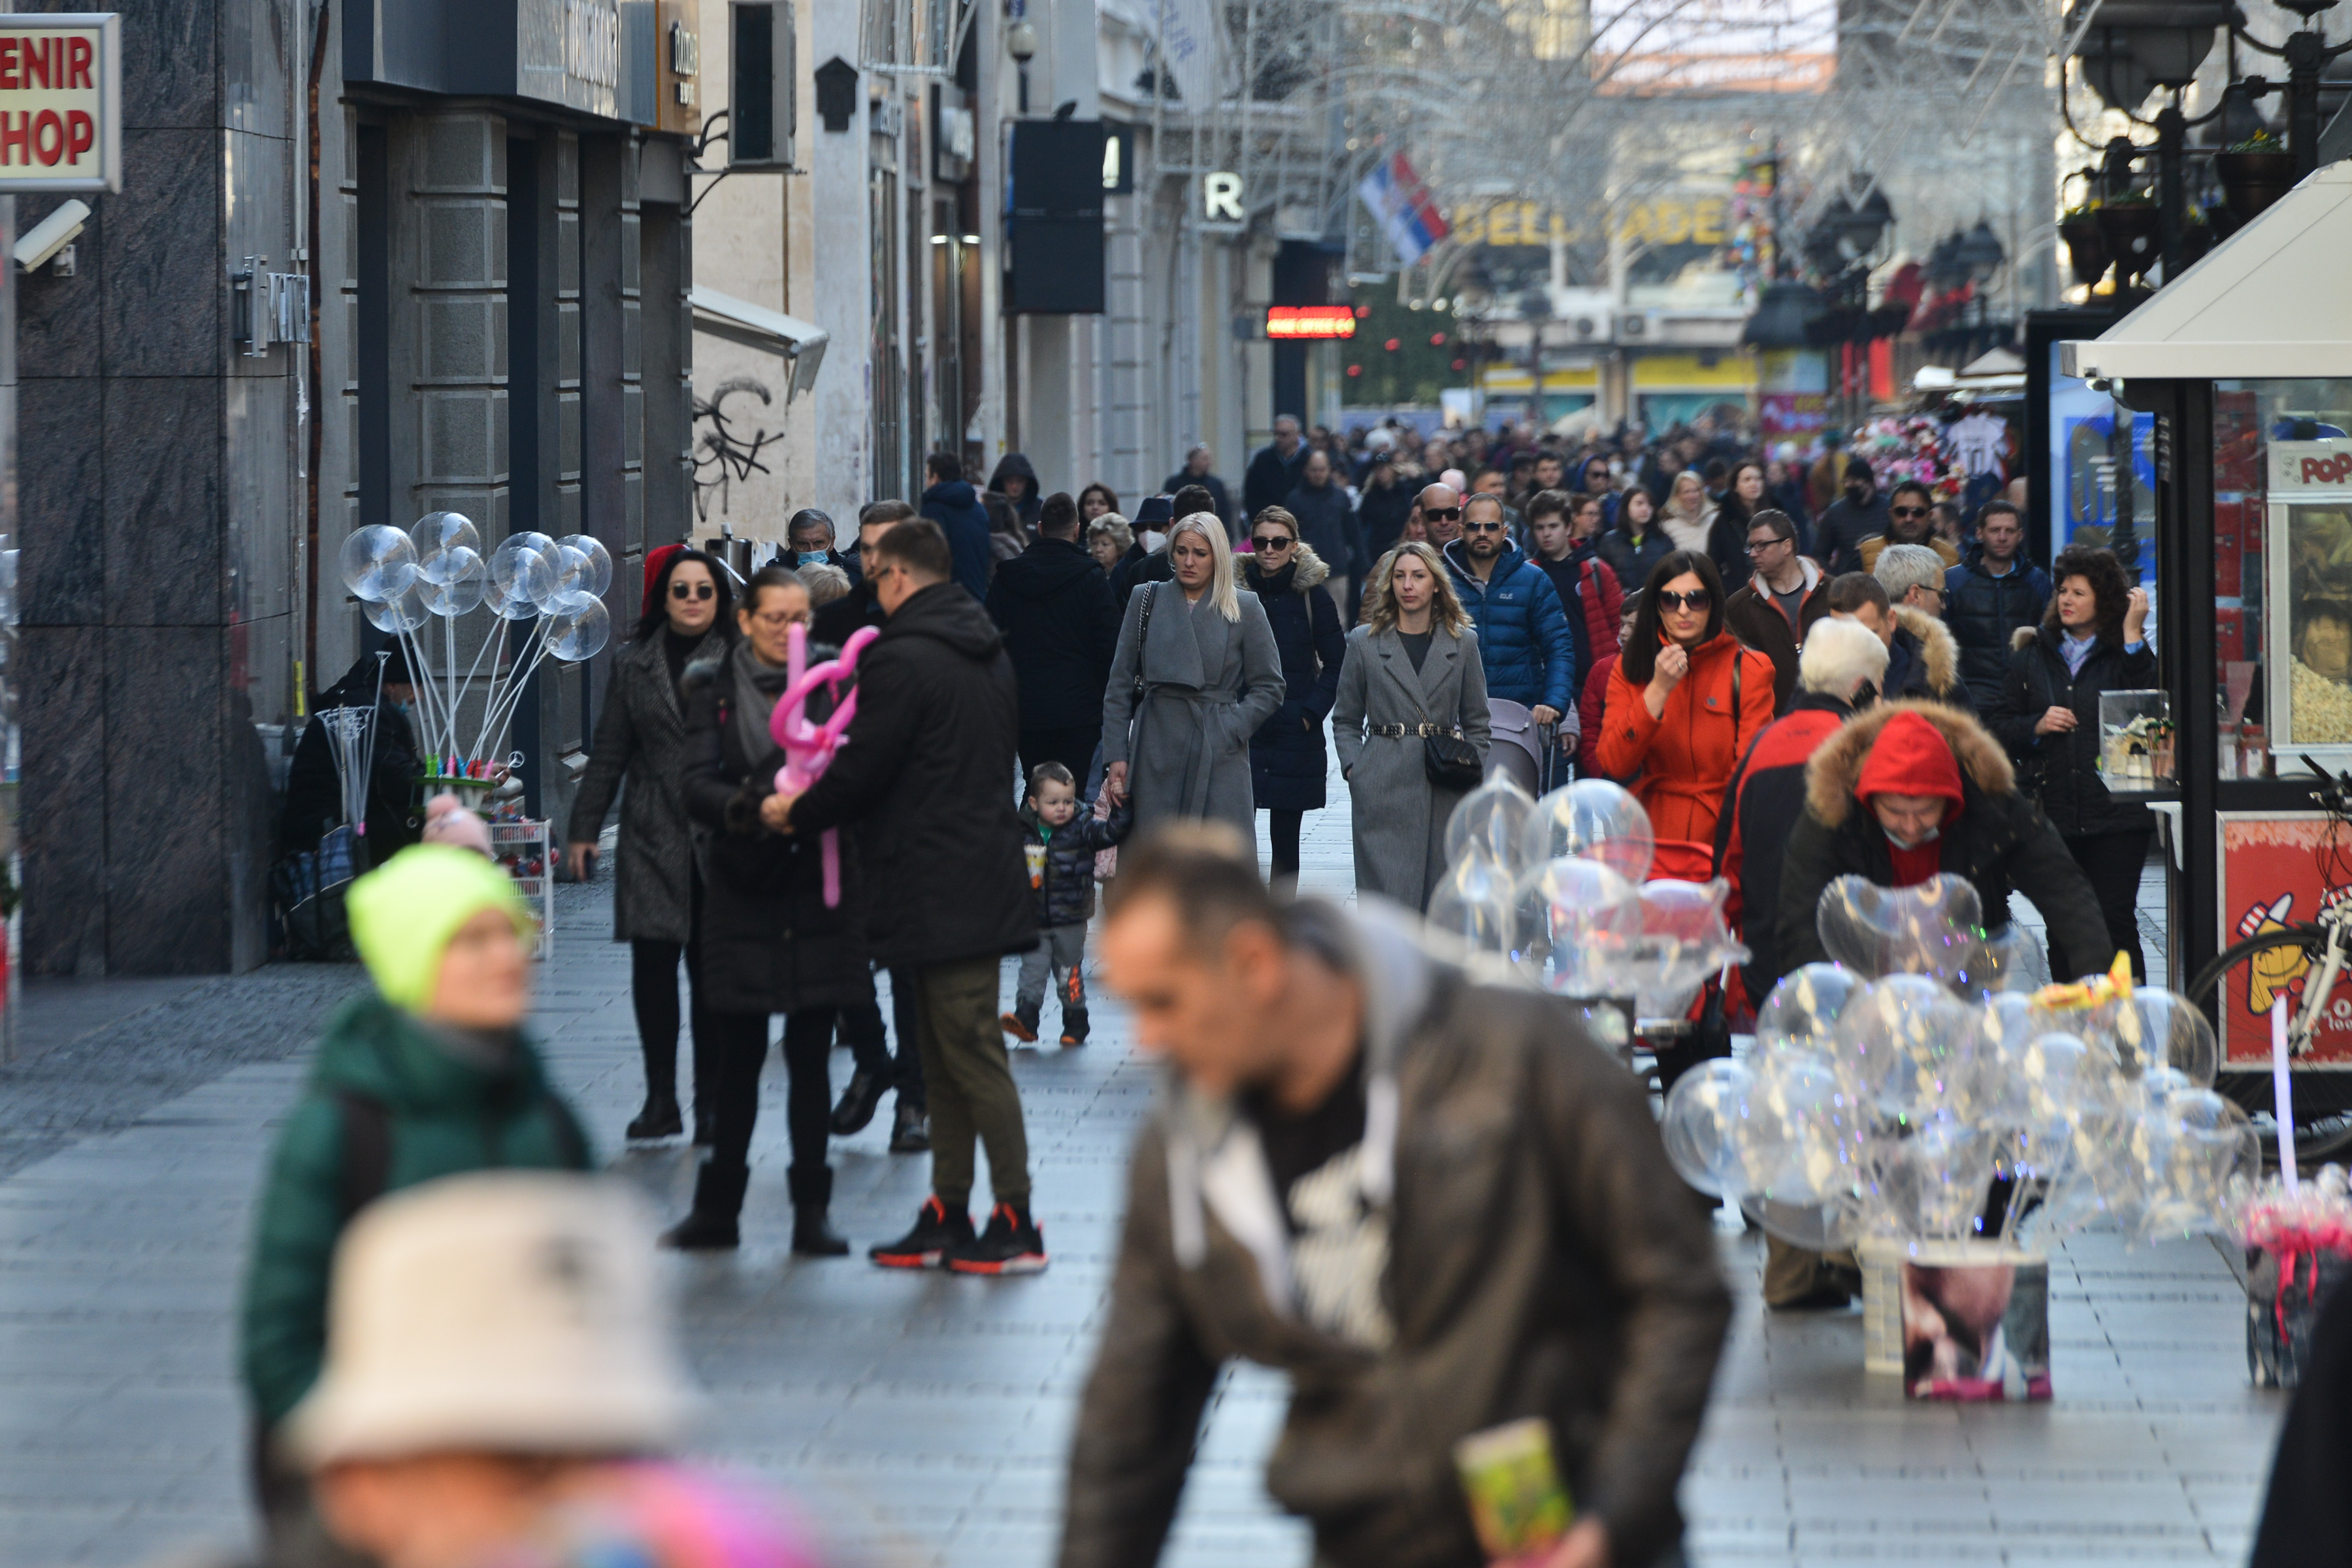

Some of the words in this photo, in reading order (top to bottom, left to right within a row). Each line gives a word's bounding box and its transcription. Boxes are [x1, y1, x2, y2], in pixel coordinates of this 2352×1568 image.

[0, 37, 93, 90] ENIR
[0, 108, 93, 167] HOP
[1205, 171, 1243, 220] R
[1454, 199, 1727, 246] BELADE
[2300, 452, 2352, 484] POP
